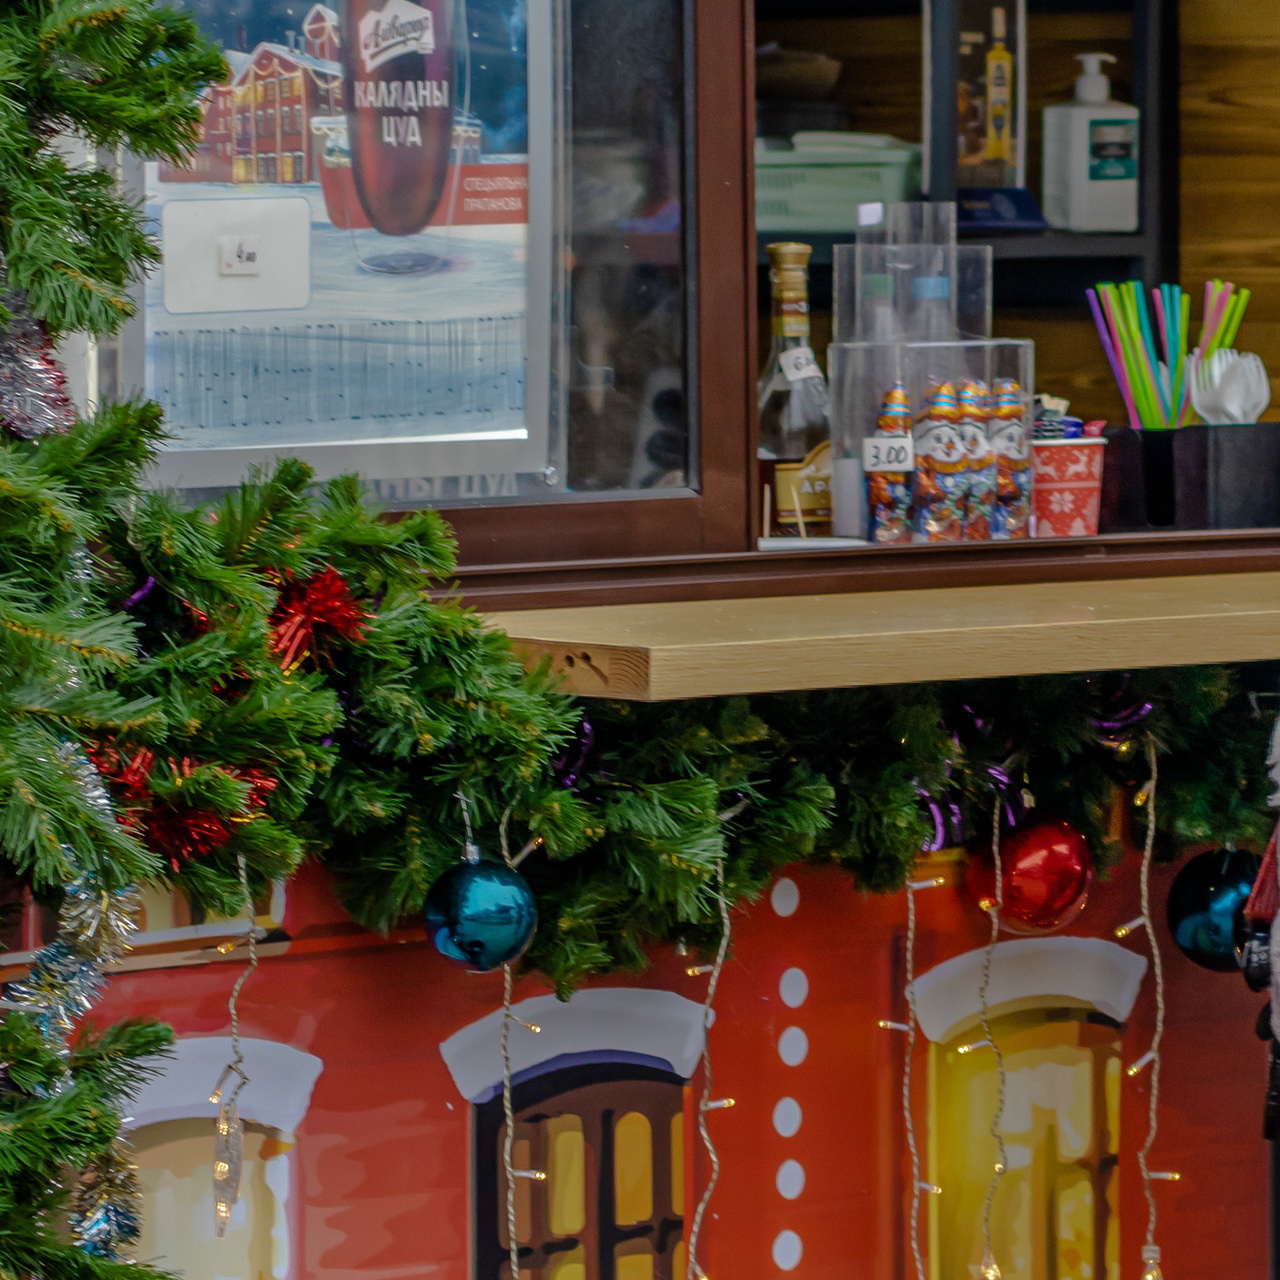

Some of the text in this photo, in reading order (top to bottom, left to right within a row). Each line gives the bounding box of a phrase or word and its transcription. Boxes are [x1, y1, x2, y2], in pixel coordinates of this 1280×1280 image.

[353, 80, 449, 113] КАЛЯДНЫ
[381, 116, 423, 147] ЦУД
[870, 444, 909, 467] 3.00
